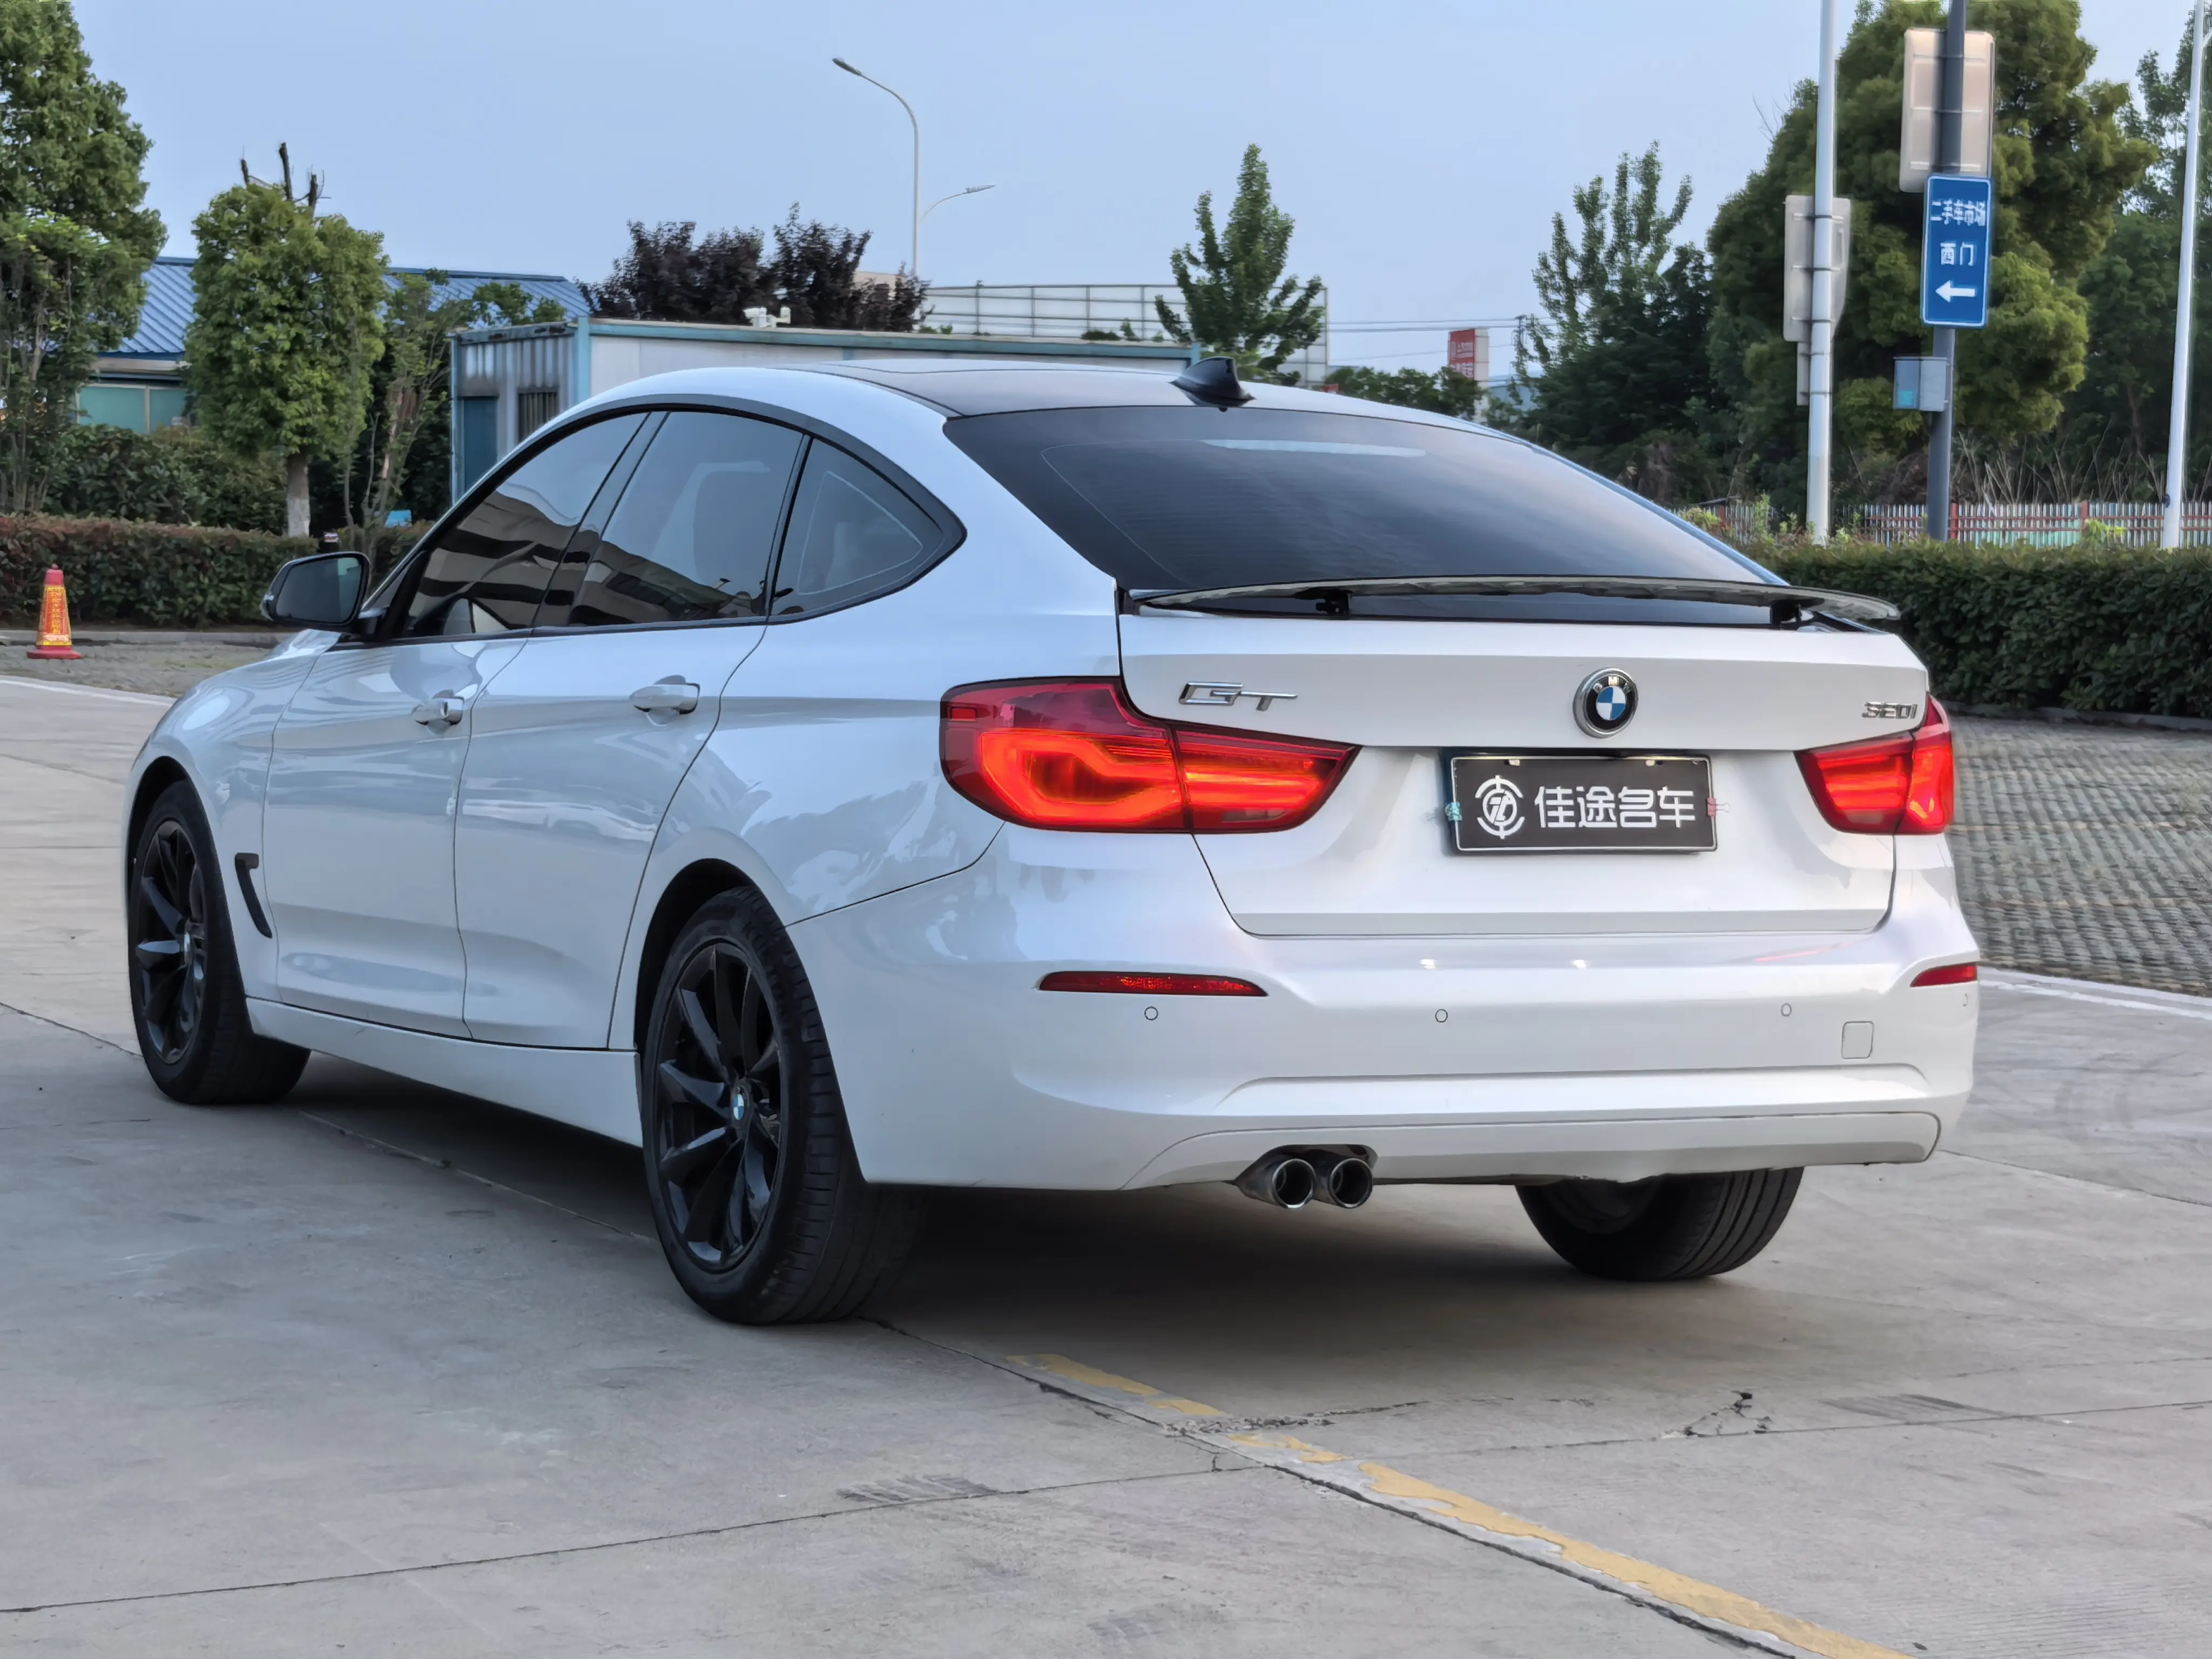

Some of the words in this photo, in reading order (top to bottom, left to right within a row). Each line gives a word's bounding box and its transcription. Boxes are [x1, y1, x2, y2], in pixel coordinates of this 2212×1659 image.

[1940, 242, 1974, 266] 西门
[1179, 682, 1298, 711] GT
[1534, 786, 1696, 828] 佳途名车
